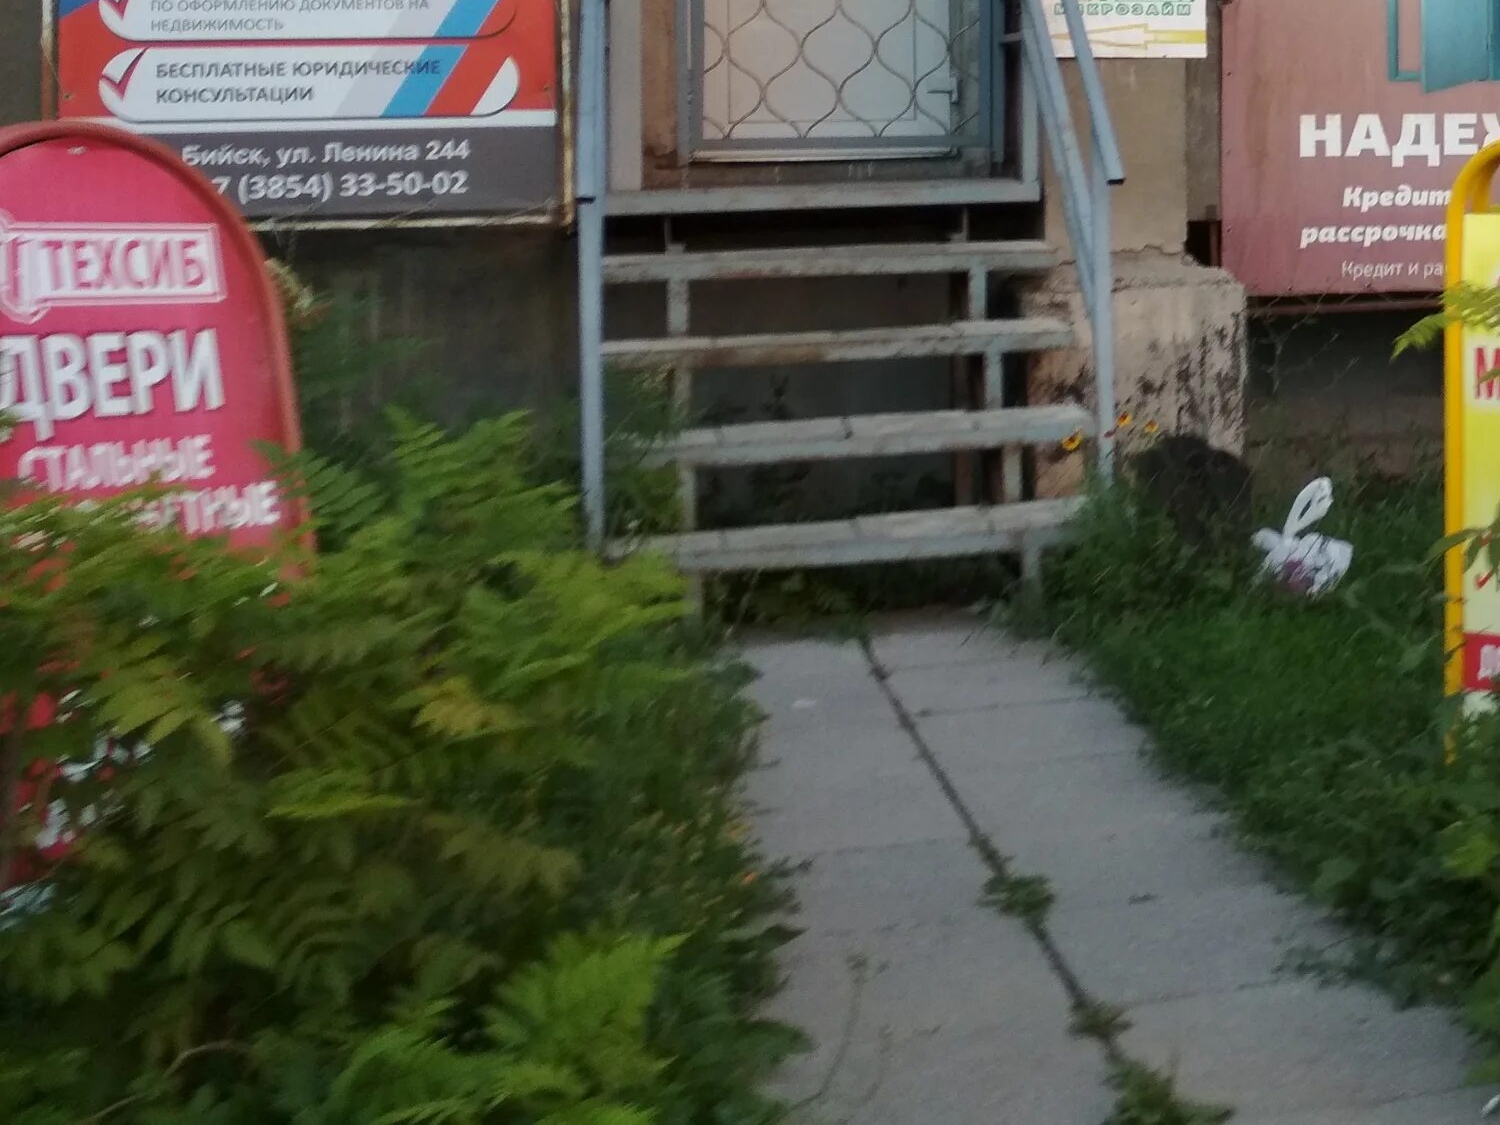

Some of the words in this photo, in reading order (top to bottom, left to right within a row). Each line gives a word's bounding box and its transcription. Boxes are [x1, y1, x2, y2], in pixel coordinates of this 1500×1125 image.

[151, 0, 173, 12] ПО
[151, 18, 284, 32] НЕДВИЖИМОСТЬ
[156, 61, 285, 79] БЕСПЛАТНЫЕ
[293, 59, 441, 78] ЮРИДИЧЕСКИЕ
[156, 85, 315, 105] КОНСУЛЬТАЦИИ
[182, 144, 270, 168] Бийск,
[276, 146, 315, 169] ул.
[321, 141, 419, 163] Ленина
[425, 139, 470, 161] 244
[238, 172, 332, 204] (3854)
[340, 171, 469, 197] 33-50-02
[1342, 185, 1452, 211] Кредит
[1300, 224, 1449, 249] рассрочка
[1342, 261, 1403, 278] Кредит
[1408, 262, 1419, 276] и
[0, 328, 226, 441] ДВЕРИ
